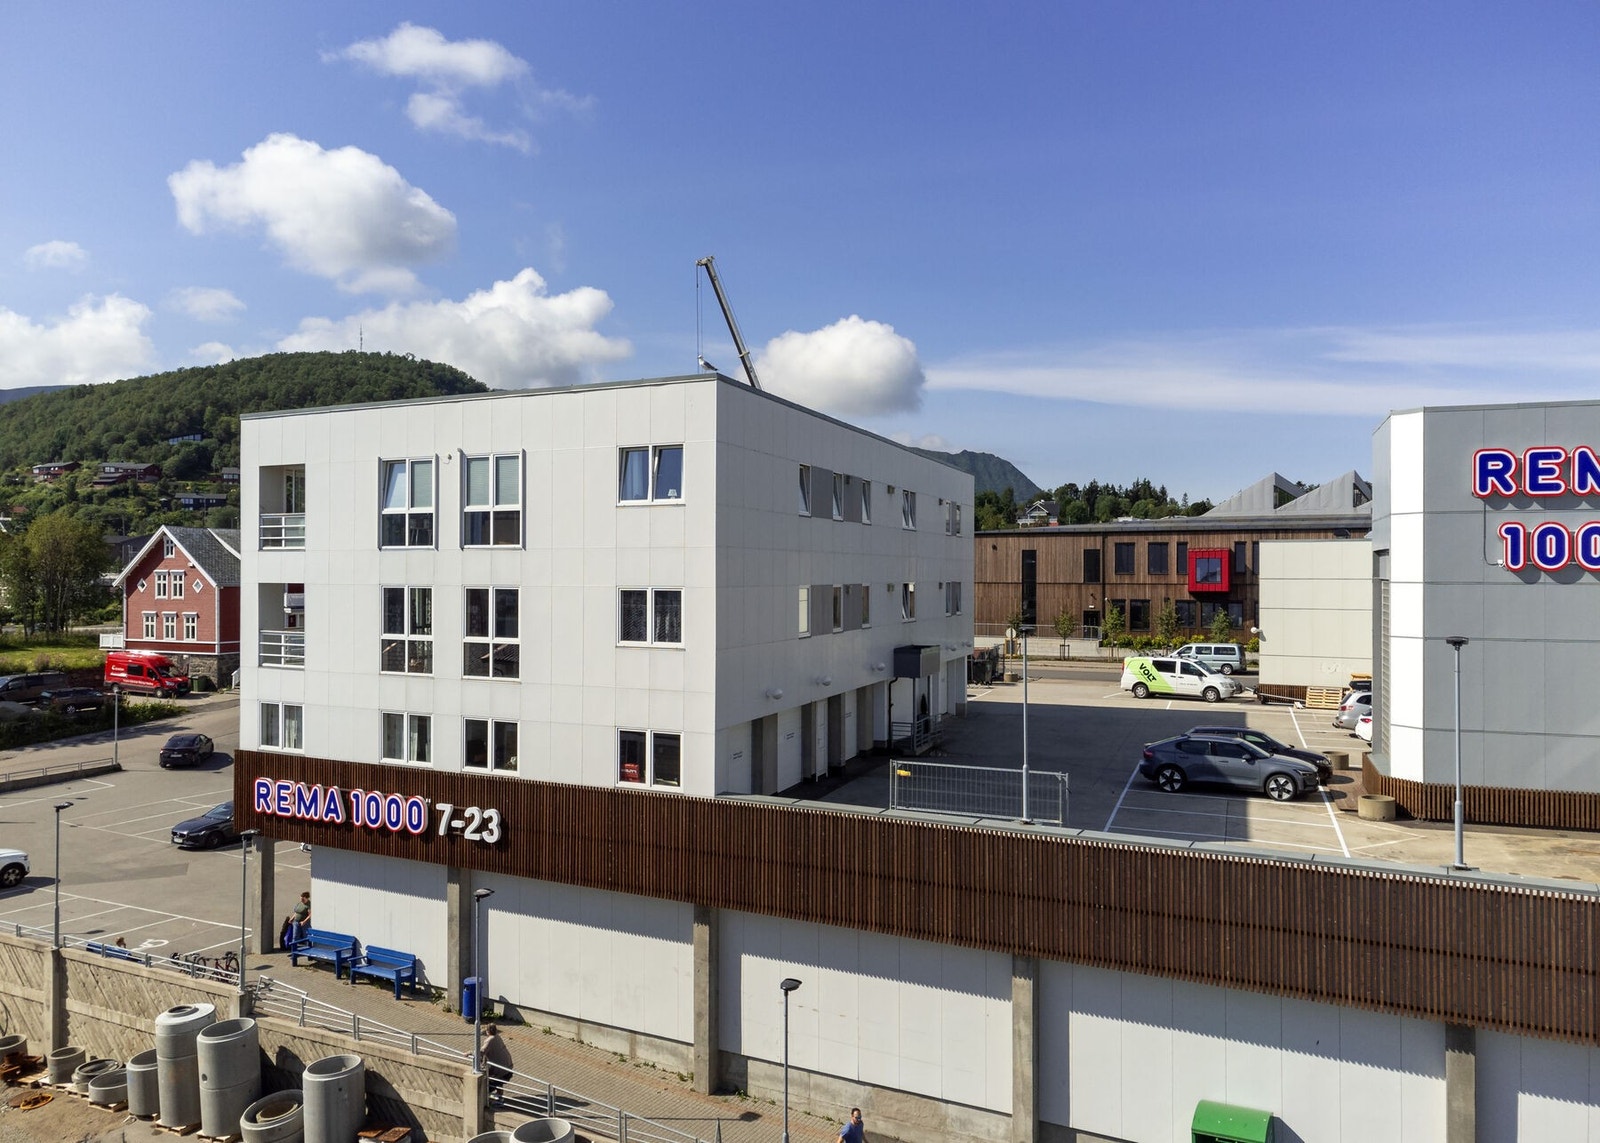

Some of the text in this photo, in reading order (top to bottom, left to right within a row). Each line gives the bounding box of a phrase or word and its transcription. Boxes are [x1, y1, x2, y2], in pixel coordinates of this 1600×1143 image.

[1139, 662, 1157, 683] VOLT
[254, 777, 501, 843] REMA 1000 7-23
